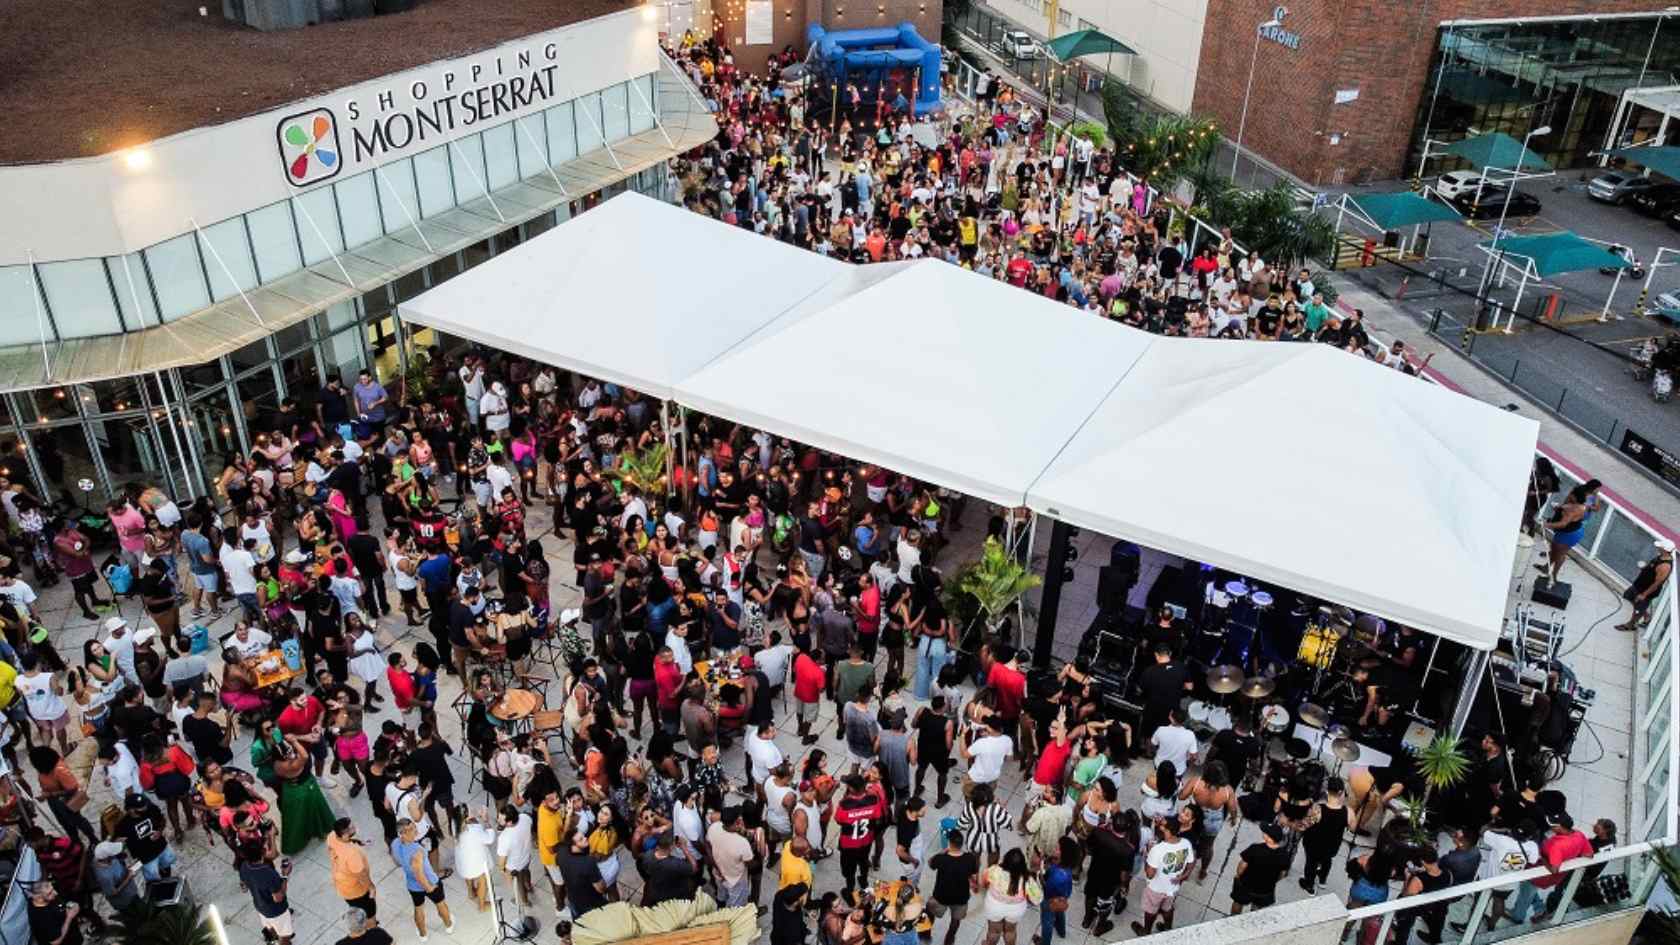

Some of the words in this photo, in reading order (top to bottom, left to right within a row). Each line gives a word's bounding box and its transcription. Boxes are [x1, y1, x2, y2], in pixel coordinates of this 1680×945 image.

[348, 43, 556, 120] SHOPPING
[352, 65, 558, 162] MONTSERRAT
[420, 523, 434, 537] 10
[851, 818, 870, 840] 13
